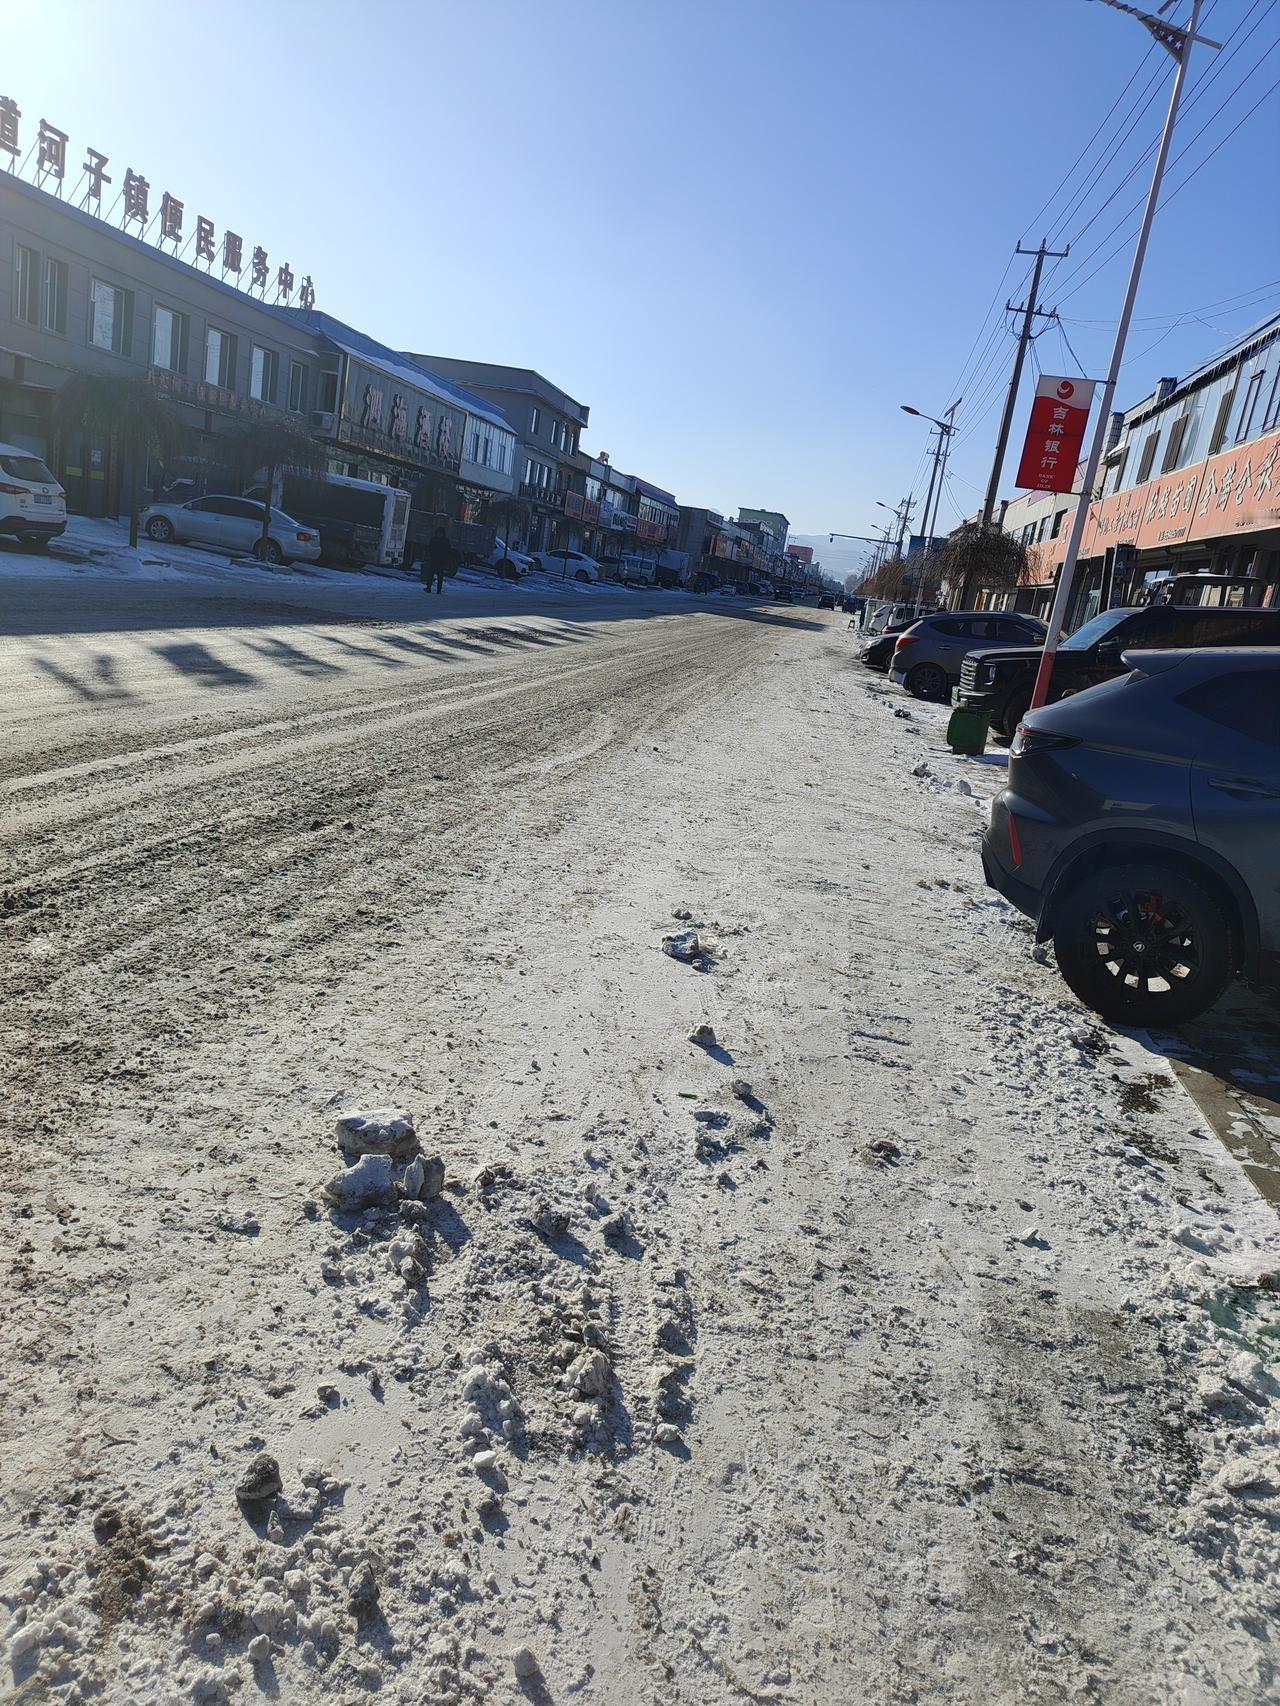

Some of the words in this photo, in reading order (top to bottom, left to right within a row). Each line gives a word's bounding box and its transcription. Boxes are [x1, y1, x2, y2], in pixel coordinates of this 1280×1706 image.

[0, 95, 315, 310] 道河子镇便民服务中心
[1040, 405, 1069, 469] 吉林银行
